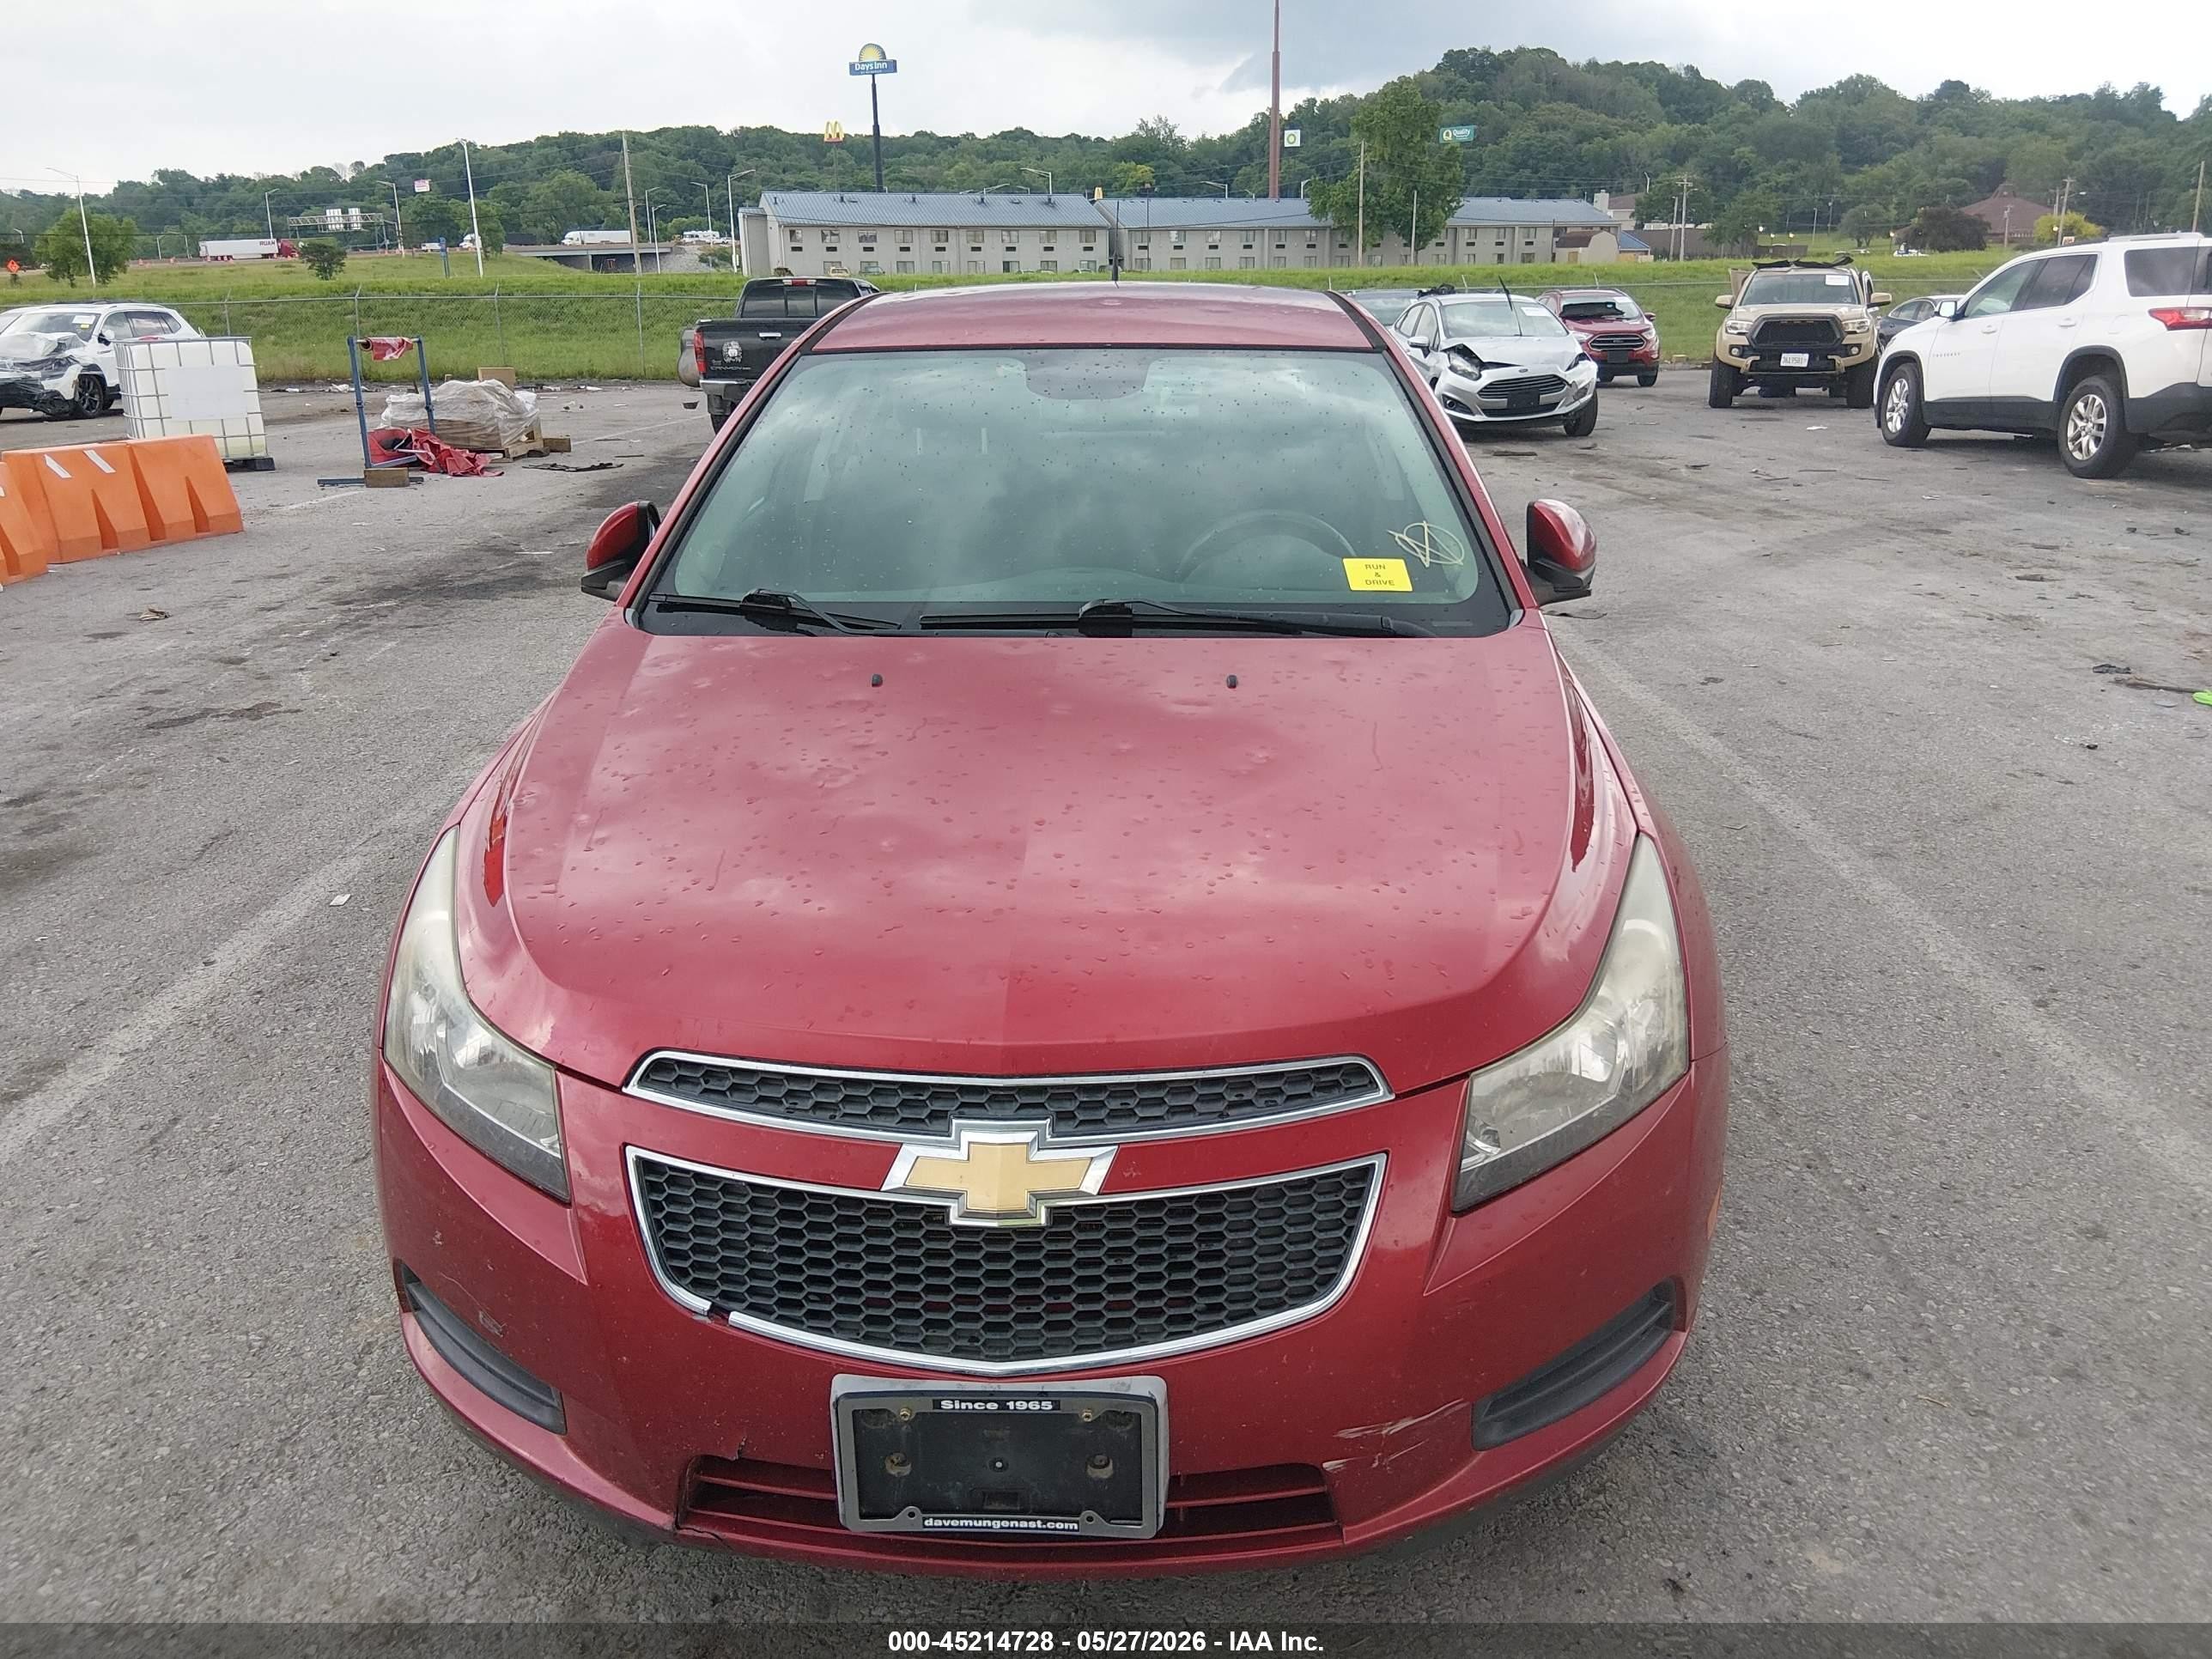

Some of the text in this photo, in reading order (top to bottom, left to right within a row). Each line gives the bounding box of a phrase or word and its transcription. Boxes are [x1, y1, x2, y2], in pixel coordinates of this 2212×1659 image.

[940, 1399, 1054, 1410] Since 1965
[922, 1517, 1079, 1531] davemungenast.com
